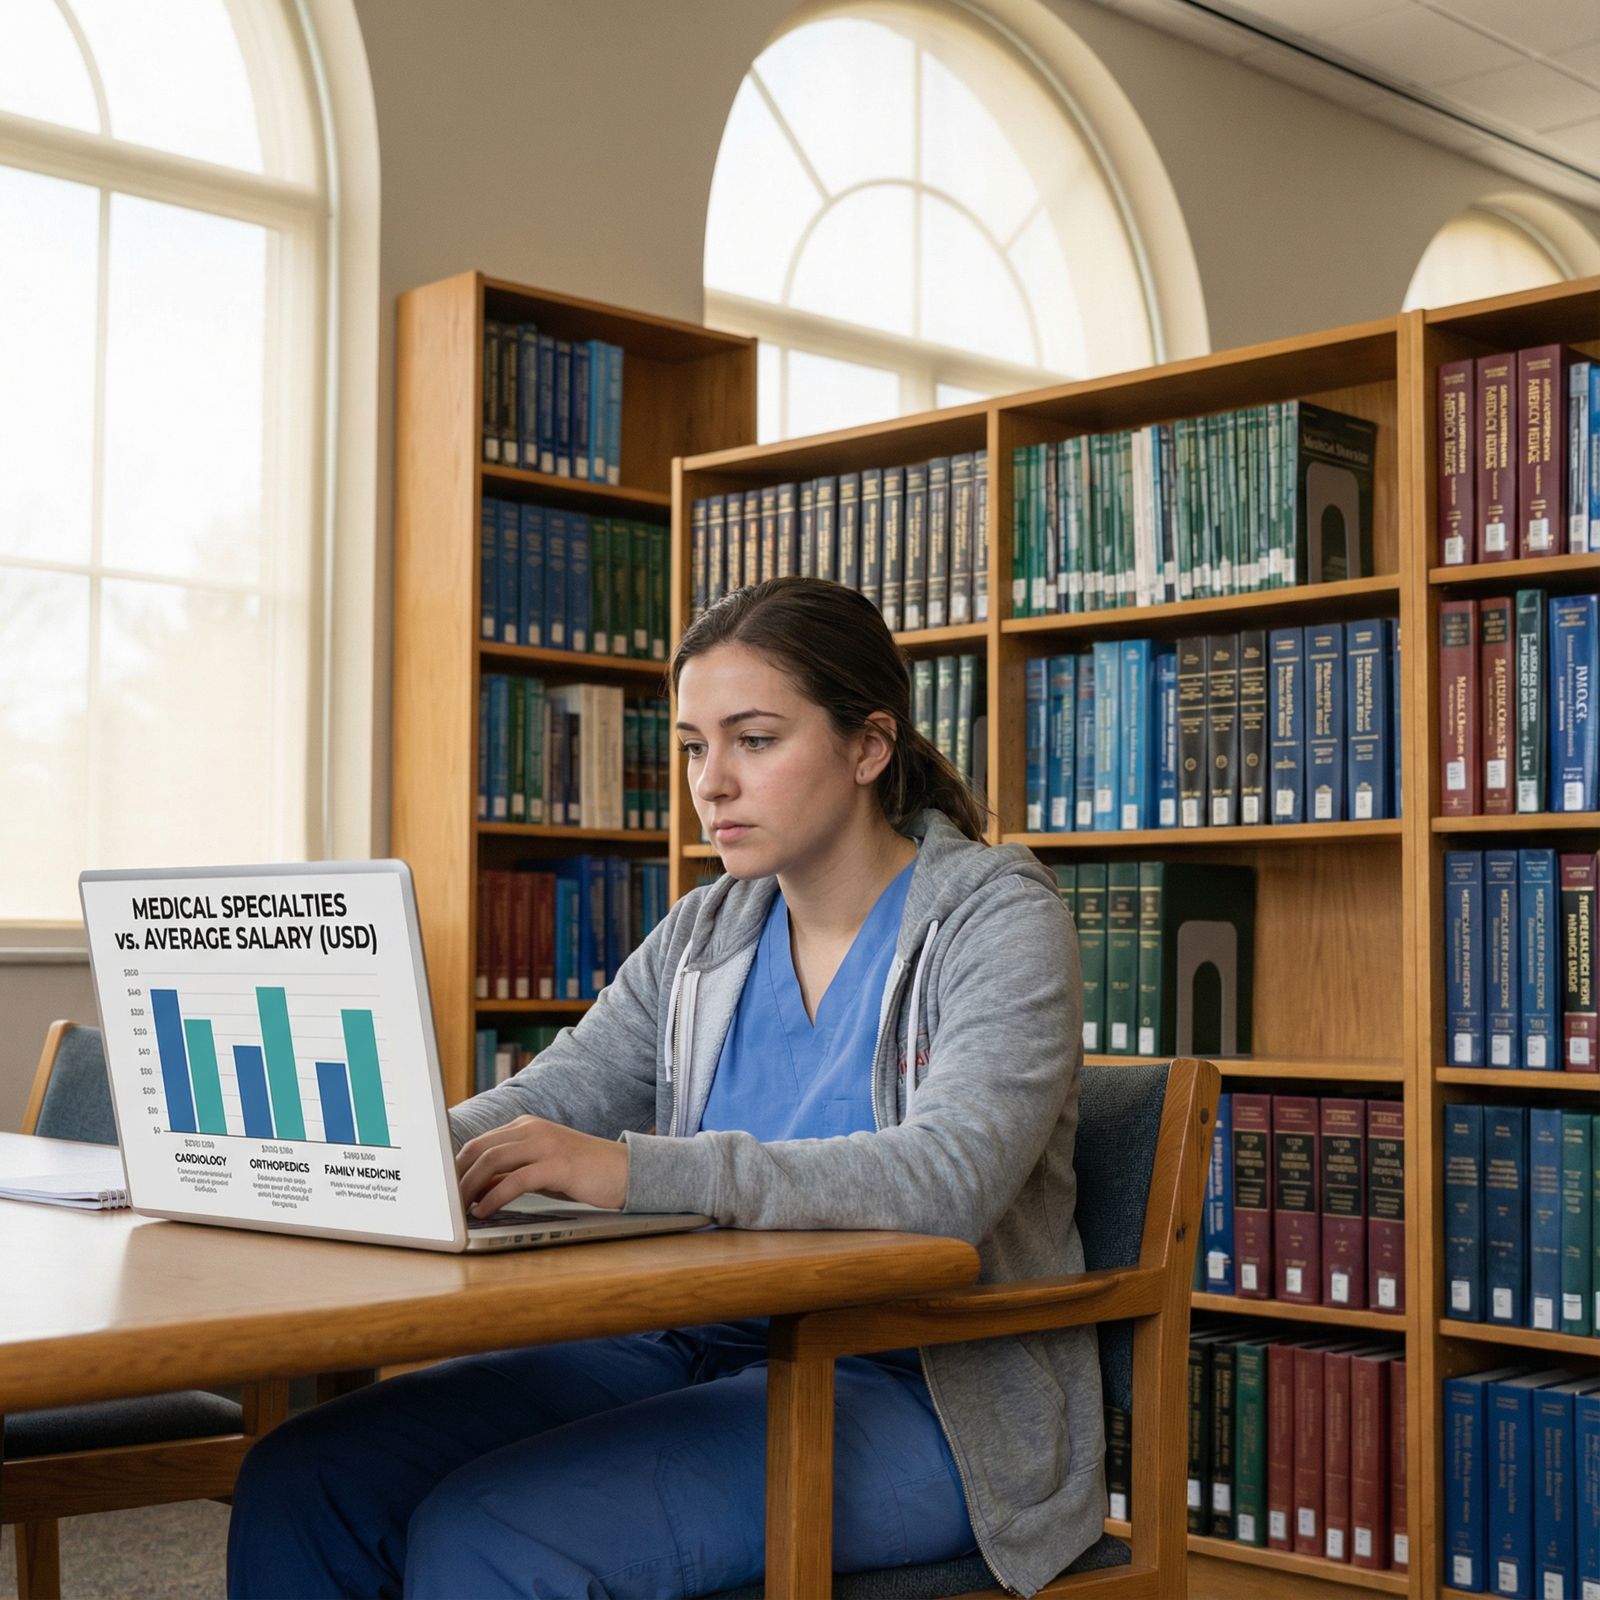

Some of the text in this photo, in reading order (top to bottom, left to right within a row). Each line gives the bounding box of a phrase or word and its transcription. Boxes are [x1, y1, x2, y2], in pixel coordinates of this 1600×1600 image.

[132, 893, 347, 920] MEDICAL SPECIALTIES
[115, 924, 378, 955] vs. AVERAGE SALARY (USD)
[175, 1152, 228, 1167] CARDIOLOGY
[249, 1158, 310, 1173] ORTHOPEDICS
[324, 1164, 402, 1180] FAMILY MEDICINE
